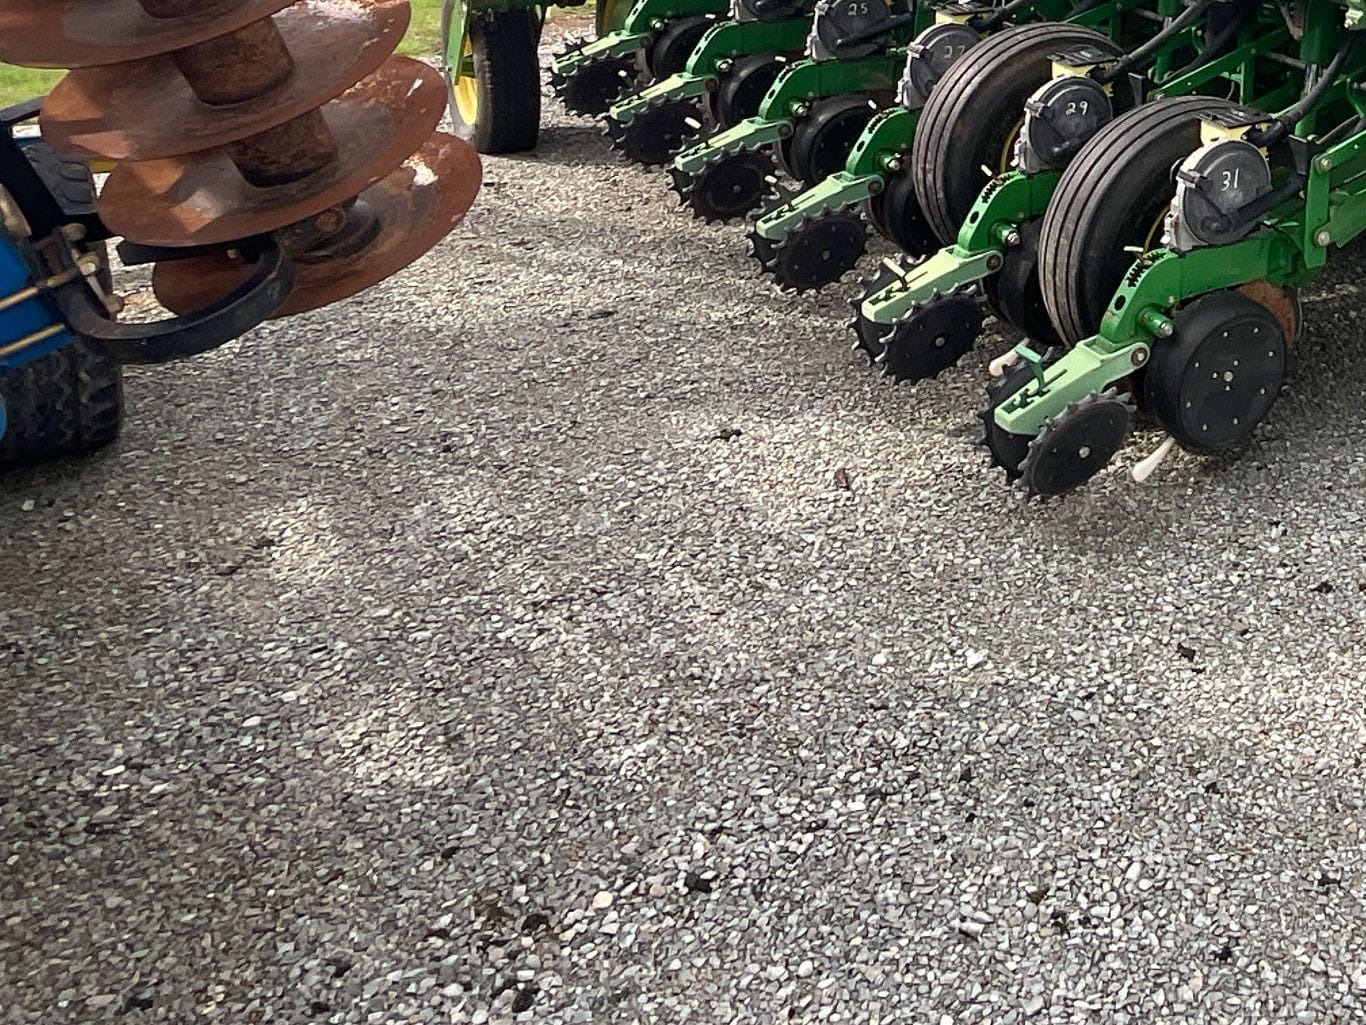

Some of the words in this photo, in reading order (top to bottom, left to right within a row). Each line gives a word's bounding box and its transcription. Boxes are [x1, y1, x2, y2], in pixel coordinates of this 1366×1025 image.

[847, 2, 869, 16] 25
[943, 45, 965, 59] 27
[1065, 100, 1089, 116] 29
[1221, 167, 1239, 192] 31
